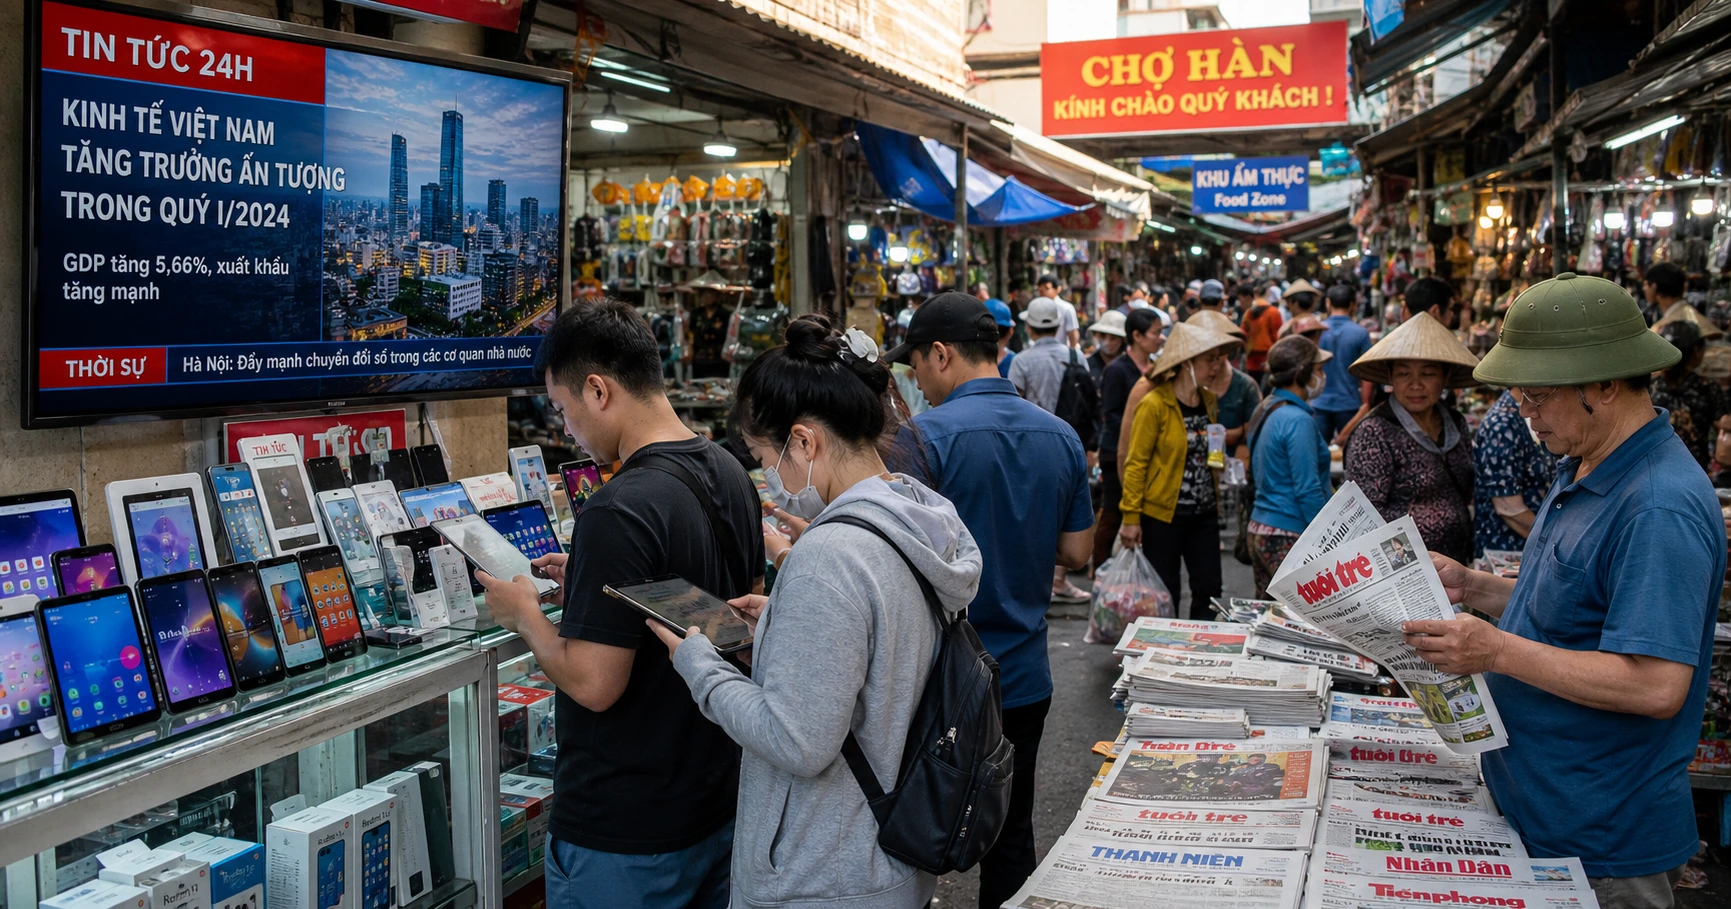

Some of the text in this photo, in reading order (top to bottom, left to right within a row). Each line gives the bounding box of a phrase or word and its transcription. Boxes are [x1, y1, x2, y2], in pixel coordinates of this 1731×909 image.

[61, 27, 253, 82] TIN TỨC 24H
[1081, 36, 1295, 91] CHỢ HÀN
[1053, 82, 1333, 120] KÍNH CHÀO QUÝ KHÁCH !
[62, 98, 275, 146] KINH TẾ VIỆT NAM
[60, 139, 346, 194] TĂNG TRƯỞNG ẤN TƯỢNG
[1196, 169, 1230, 188] KHU
[1260, 164, 1305, 189] THỰC
[60, 190, 290, 229] TRONG QUÝ I/2024
[1214, 191, 1286, 207] Food Zone
[63, 252, 289, 278] GDP tăng 5,66%, xuất khẩu
[62, 280, 160, 304] tăng mạnh
[65, 354, 147, 379] THỜI SỰ
[183, 344, 532, 374] Hà Nội: Đẩy mạnh chuyển đổi số trong các cơ quan nhà nước
[1091, 845, 1178, 864] THANH
[1385, 856, 1512, 876] Nhân Dân
